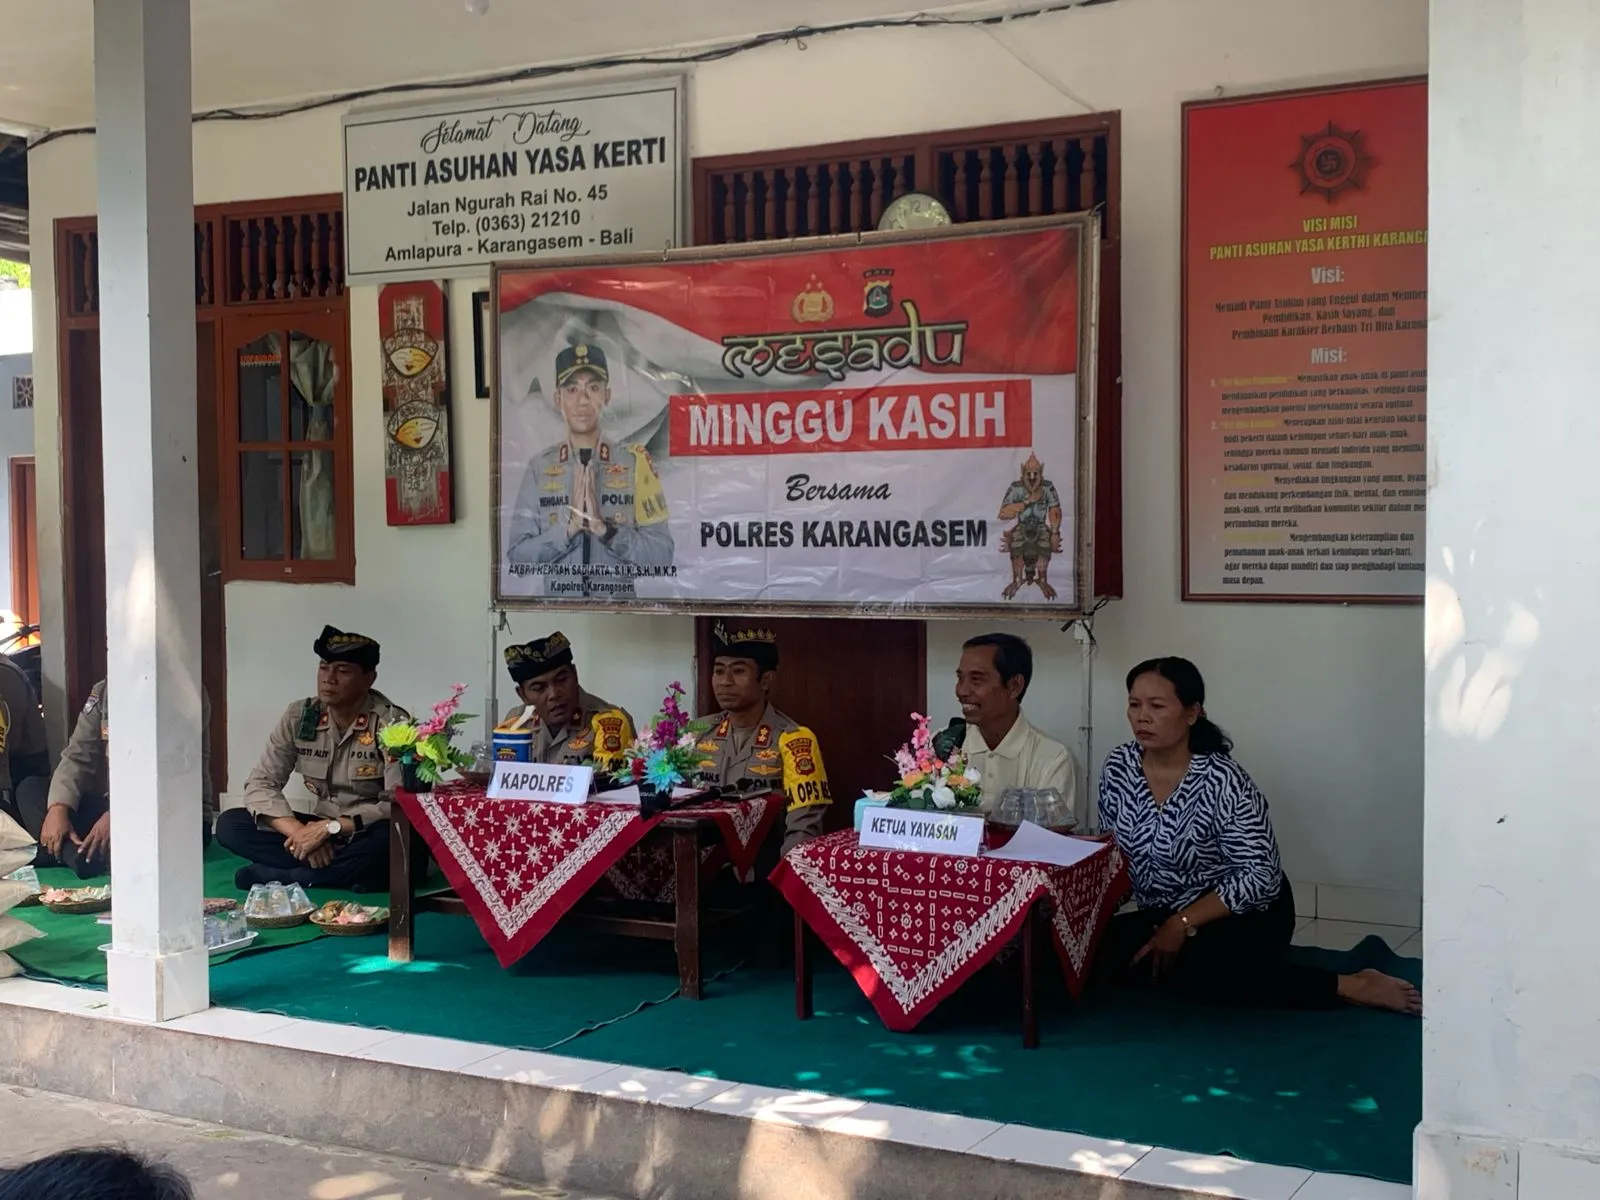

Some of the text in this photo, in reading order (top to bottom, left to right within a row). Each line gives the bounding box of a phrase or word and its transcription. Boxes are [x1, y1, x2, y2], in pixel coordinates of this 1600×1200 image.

[420, 109, 592, 155] Selamat Datang
[354, 136, 667, 193] PANTI ASUHAN YASA KERTI
[407, 183, 609, 218] Jalan Ngurah Rai No. 45
[432, 209, 581, 238] Telp. (0363) 21210
[1303, 215, 1357, 233] VISI MISI
[384, 243, 463, 264] Amlapura
[477, 231, 584, 256] Karangasem
[599, 227, 634, 246] Bali
[1210, 244, 1242, 260] PANTI
[1245, 240, 1292, 257] ASUHAN
[1295, 238, 1324, 253] YASA
[1327, 234, 1370, 250] KERTHI
[1311, 267, 1345, 284] Visi:
[1378, 306, 1395, 317] dan
[1361, 322, 1373, 332] Tri
[1311, 347, 1348, 364] Misi:
[689, 390, 1007, 446] MINGGU KASIH
[784, 473, 893, 502] Bersama
[602, 494, 634, 505] POLRI
[700, 519, 988, 548] POLRES KARANGASEM
[1400, 532, 1414, 542] dan
[551, 581, 635, 594] Kapolres Karangasem
[501, 772, 574, 794] KAPOLRES
[797, 781, 820, 803] OPS
[870, 817, 959, 841] KETUA YAYASAN
